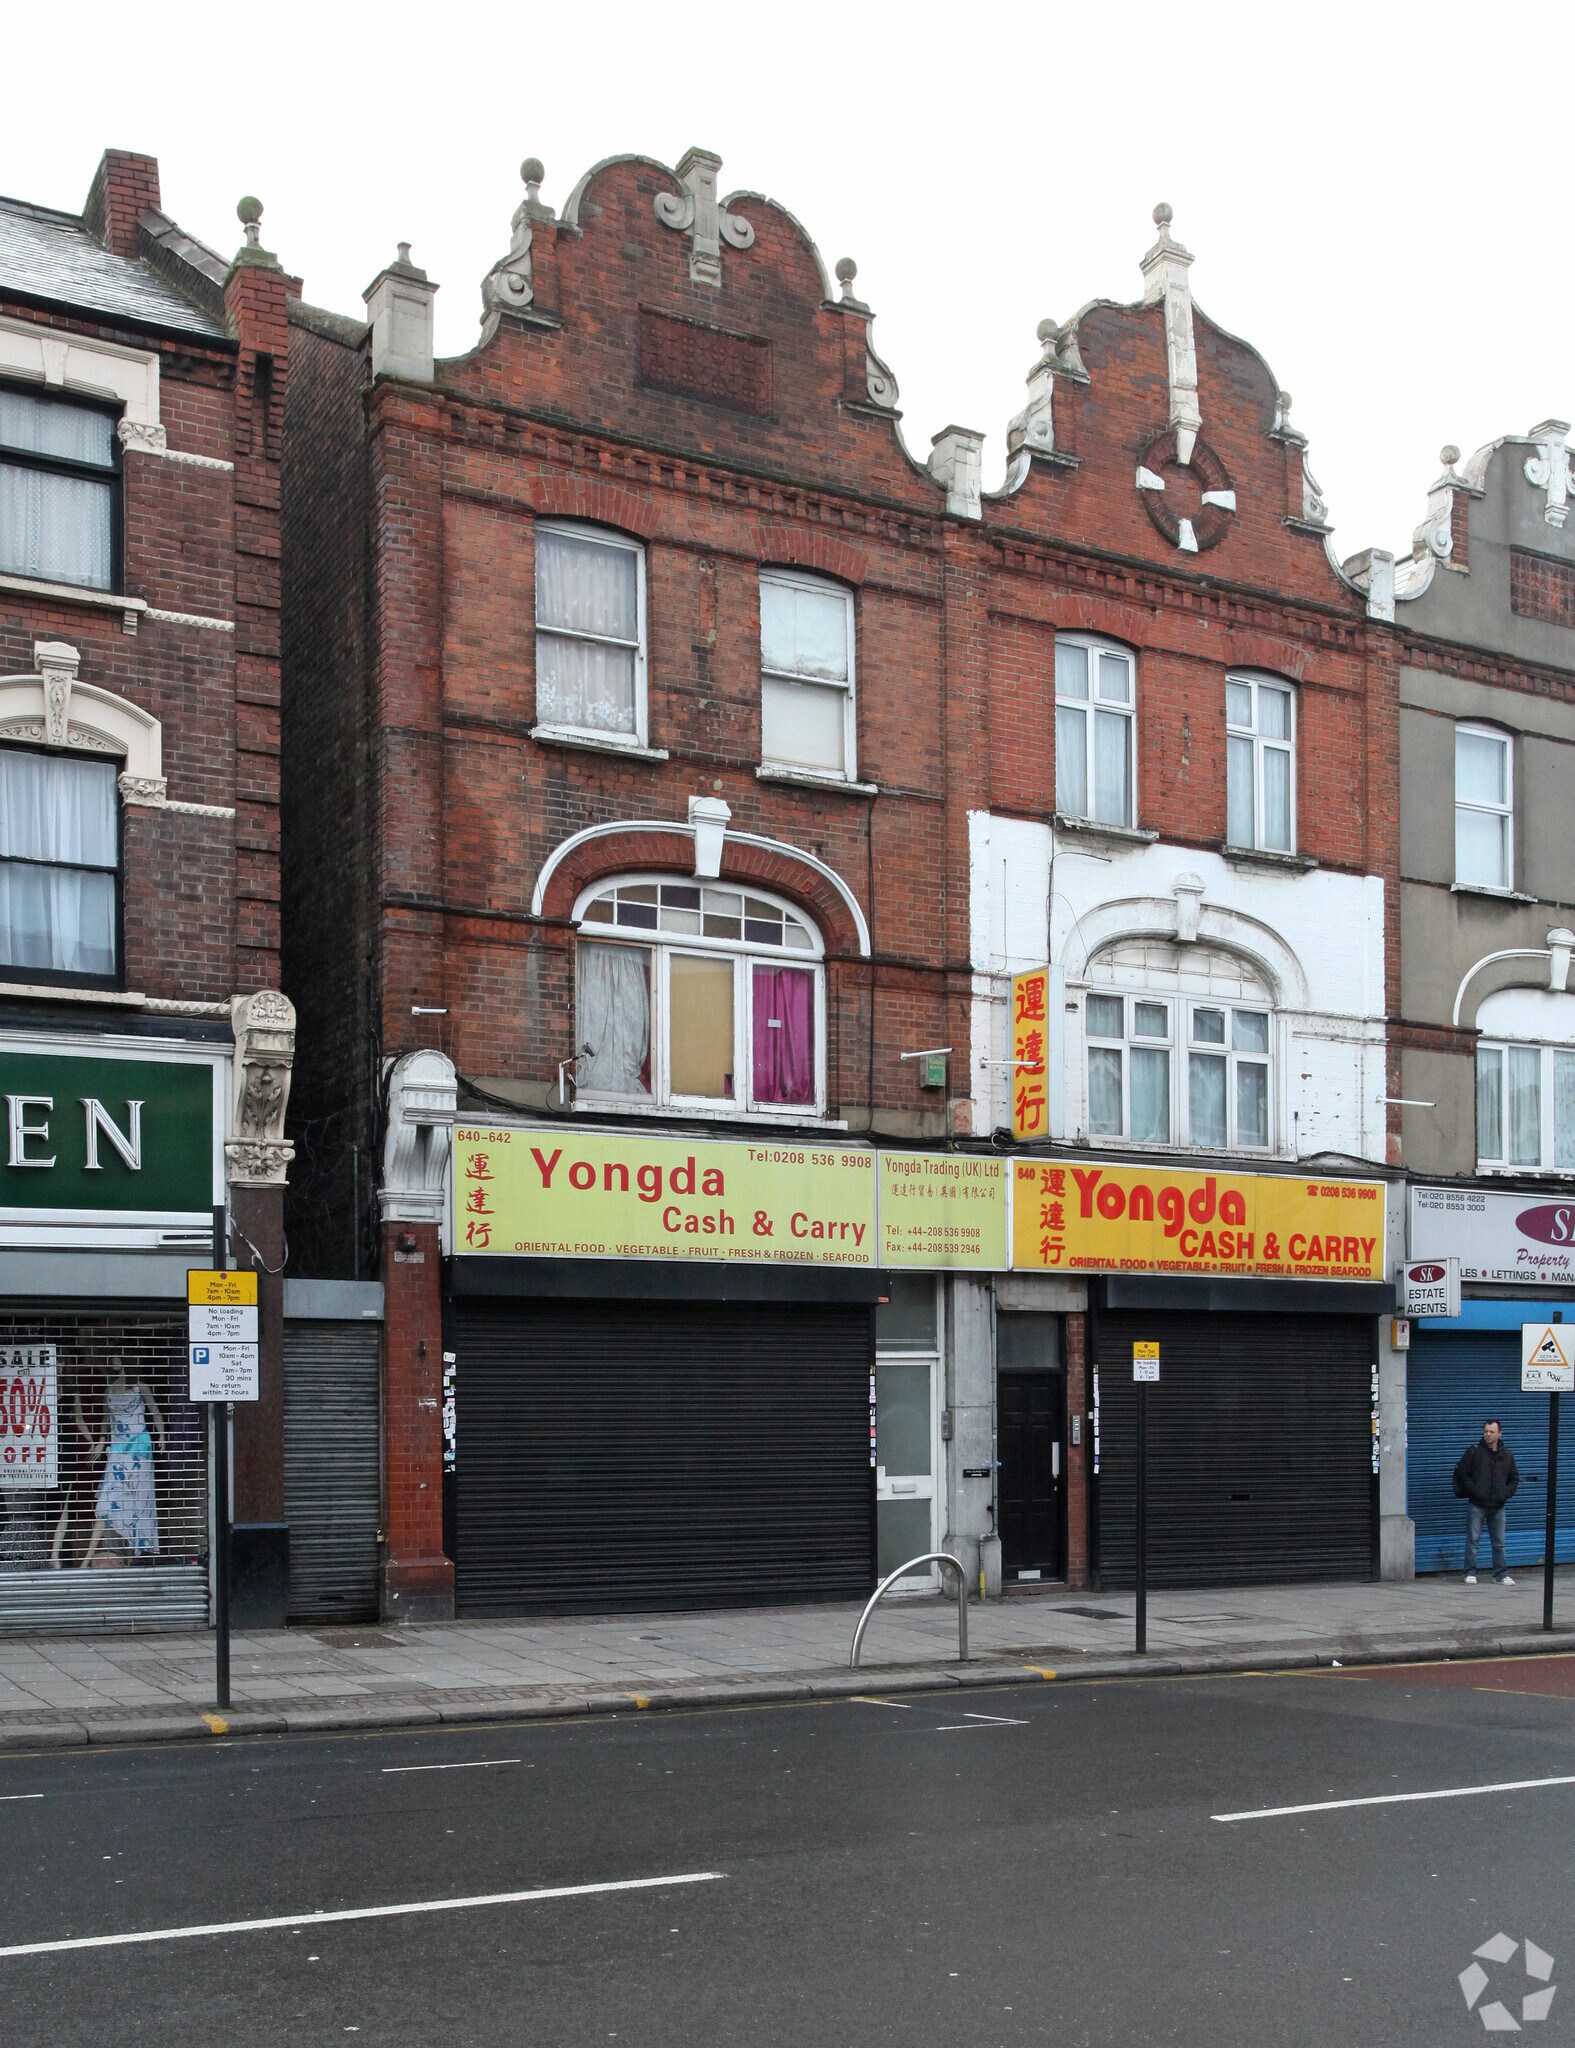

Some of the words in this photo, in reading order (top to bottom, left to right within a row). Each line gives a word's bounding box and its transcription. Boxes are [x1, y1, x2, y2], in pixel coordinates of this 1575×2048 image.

[1015, 977, 1046, 1131] 運達行
[4, 1095, 146, 1170] EN
[458, 1130, 511, 1143] 640-642
[748, 1149, 805, 1164] Tel:0208
[812, 1154, 835, 1166] 536
[841, 1155, 872, 1168] 9908
[885, 1157, 921, 1176] Yongda
[923, 1159, 960, 1179] Trading
[962, 1161, 982, 1178] (UK)
[984, 1162, 999, 1177] Ltd
[530, 1148, 725, 1202] Yongda
[1018, 1167, 1035, 1180] 640
[465, 1153, 495, 1248] 運達行
[1070, 1168, 1246, 1237] Yongda
[1321, 1187, 1340, 1198] 0208
[1342, 1188, 1356, 1198] 536
[1358, 1189, 1377, 1200] 9908
[1417, 1192, 1444, 1200] Tel:020
[1417, 1201, 1444, 1209] Tel:020
[662, 1206, 735, 1234] Cash
[752, 1210, 774, 1236] &
[791, 1212, 866, 1246] Carry
[1040, 1168, 1066, 1265] 運達行
[1551, 1209, 1575, 1241] S
[886, 1225, 903, 1235] Tel:
[907, 1227, 943, 1236] +44-208
[944, 1228, 959, 1237] 536
[961, 1229, 981, 1237] 9908
[515, 1242, 572, 1252] ORIENTAL
[574, 1243, 605, 1253] FOOD
[615, 1245, 679, 1255] VEGETABLE
[689, 1247, 719, 1257] FRUIT
[728, 1248, 761, 1258] FRESH
[764, 1250, 771, 1258] &
[774, 1250, 813, 1260] FROZEN
[822, 1252, 869, 1262] SEAFOOD
[886, 1242, 905, 1252] Fax:
[907, 1243, 943, 1253] +44-208
[944, 1244, 959, 1253] 539
[961, 1244, 981, 1253] 2946
[1180, 1229, 1255, 1259] CASH
[1263, 1232, 1280, 1260] &
[1289, 1233, 1376, 1263] CARRY
[1069, 1257, 1118, 1269] ORIENTAL
[1120, 1258, 1146, 1270] FOOD
[1157, 1260, 1210, 1272] VEGETABLE
[1220, 1262, 1246, 1273] FRUIT
[1255, 1263, 1284, 1274] FRESH
[1286, 1264, 1292, 1274] &
[1295, 1265, 1328, 1275] FROZEN
[1331, 1266, 1371, 1276] SEAFOOD
[1516, 1248, 1570, 1269] Property
[1420, 1267, 1434, 1282] SK
[1492, 1270, 1536, 1280] LETTINGS
[1551, 1272, 1575, 1281] MAN
[1408, 1288, 1444, 1299] ESTATE
[1407, 1303, 1447, 1313] AGENTS
[4, 1447, 46, 1463] OFF
